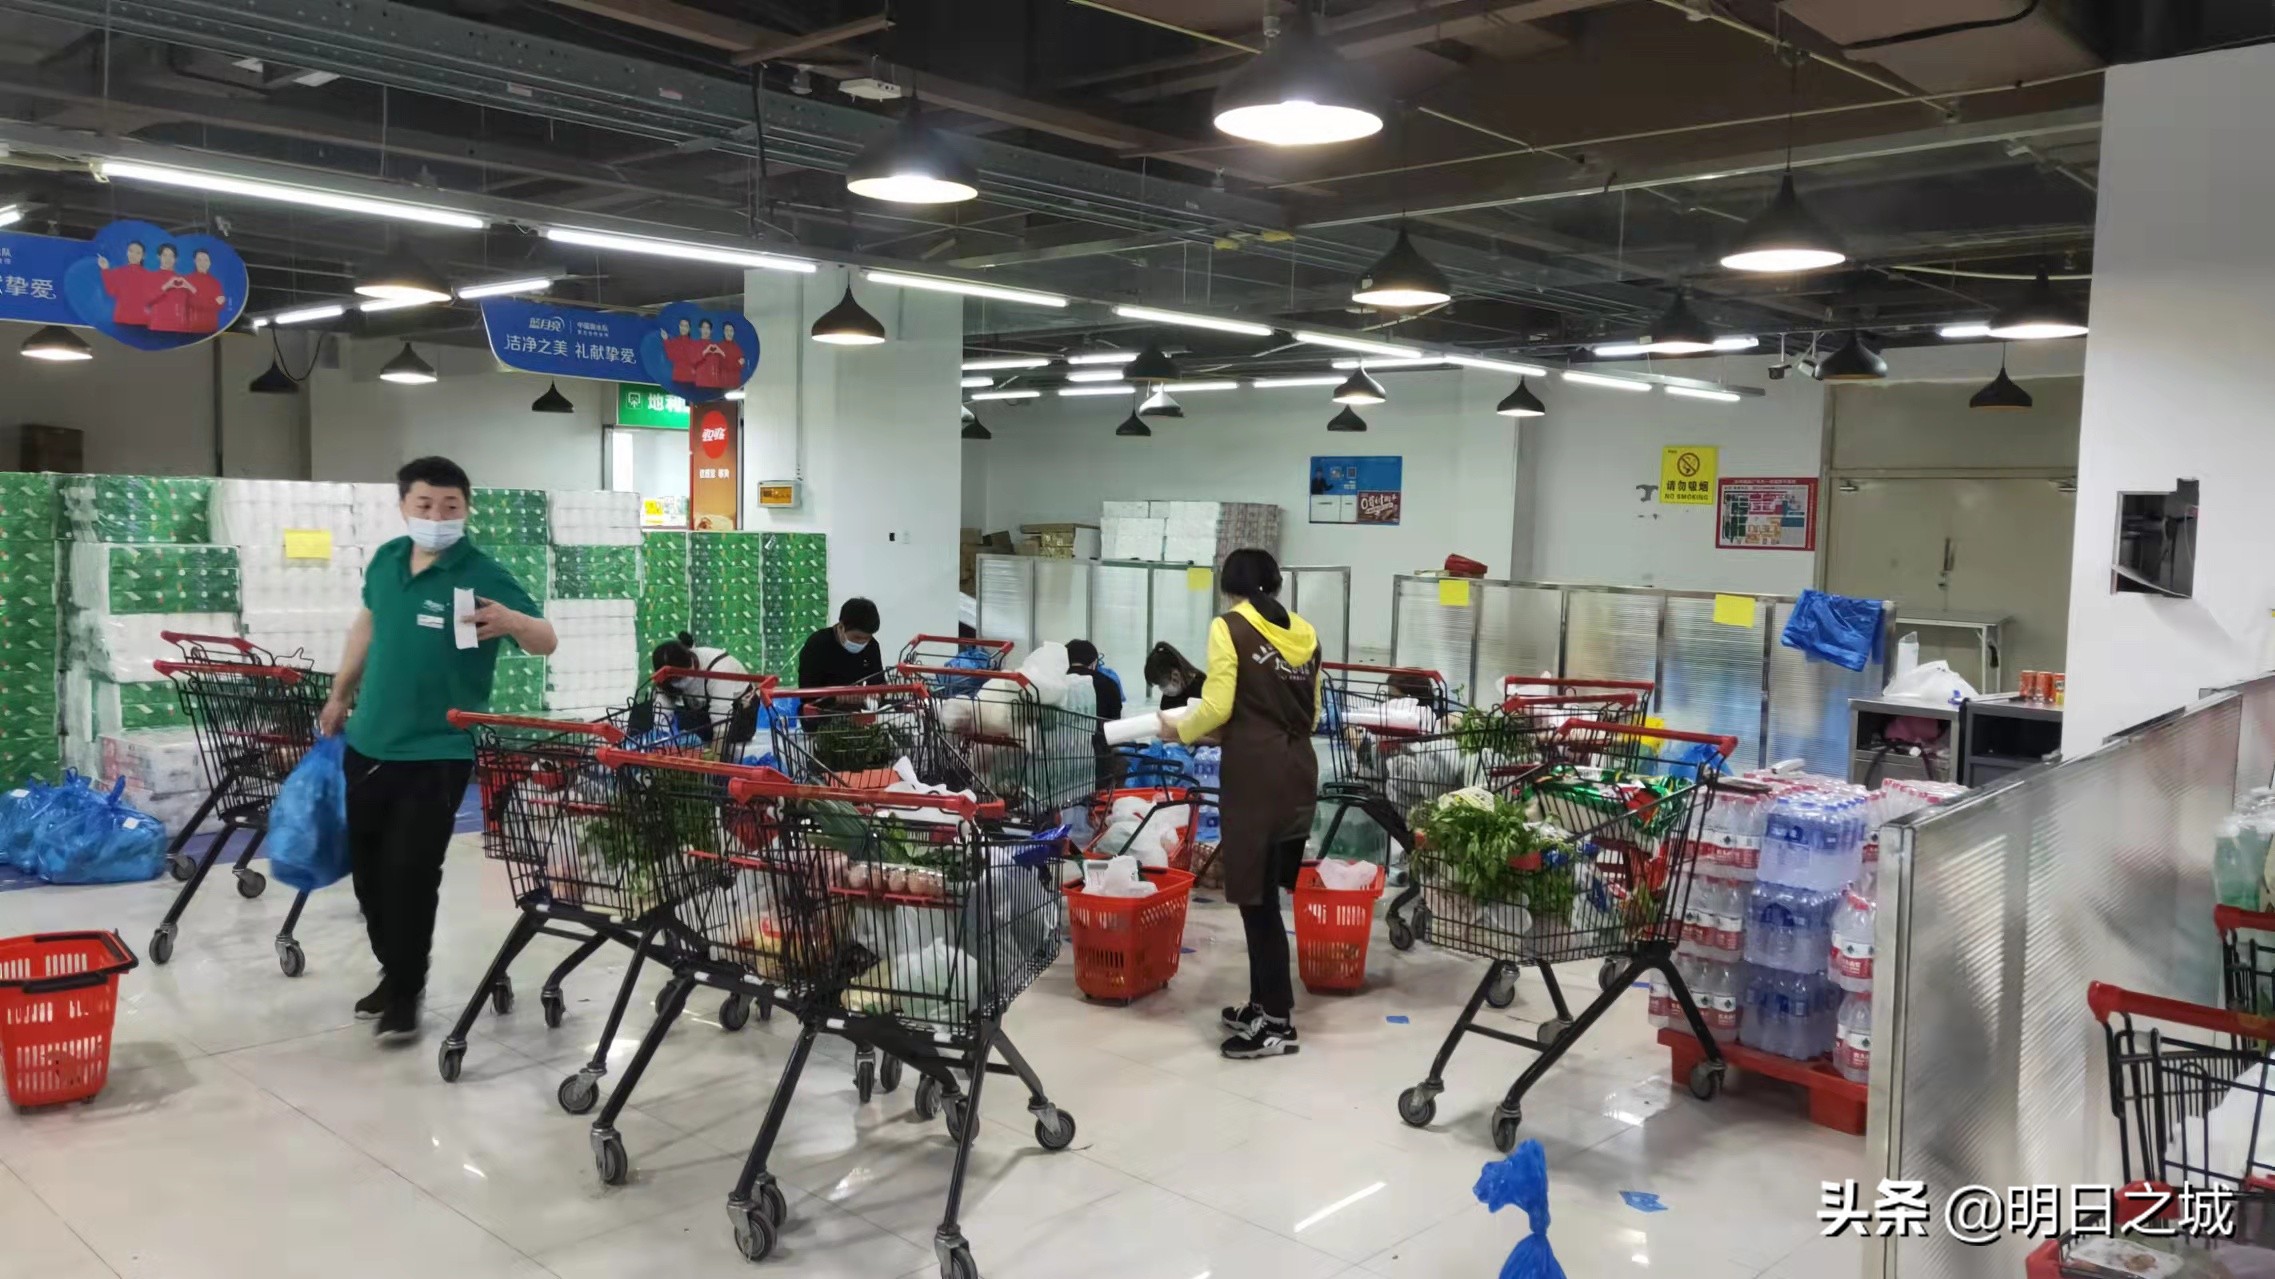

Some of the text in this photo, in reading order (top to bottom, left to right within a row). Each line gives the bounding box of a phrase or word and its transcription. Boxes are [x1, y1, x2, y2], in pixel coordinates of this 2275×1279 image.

[0, 274, 57, 300] 挚爱
[504, 333, 637, 364] 洁净之美 礼献挚爱
[1666, 480, 1709, 492] 请勿吸烟
[1676, 493, 1709, 501] SMOKING
